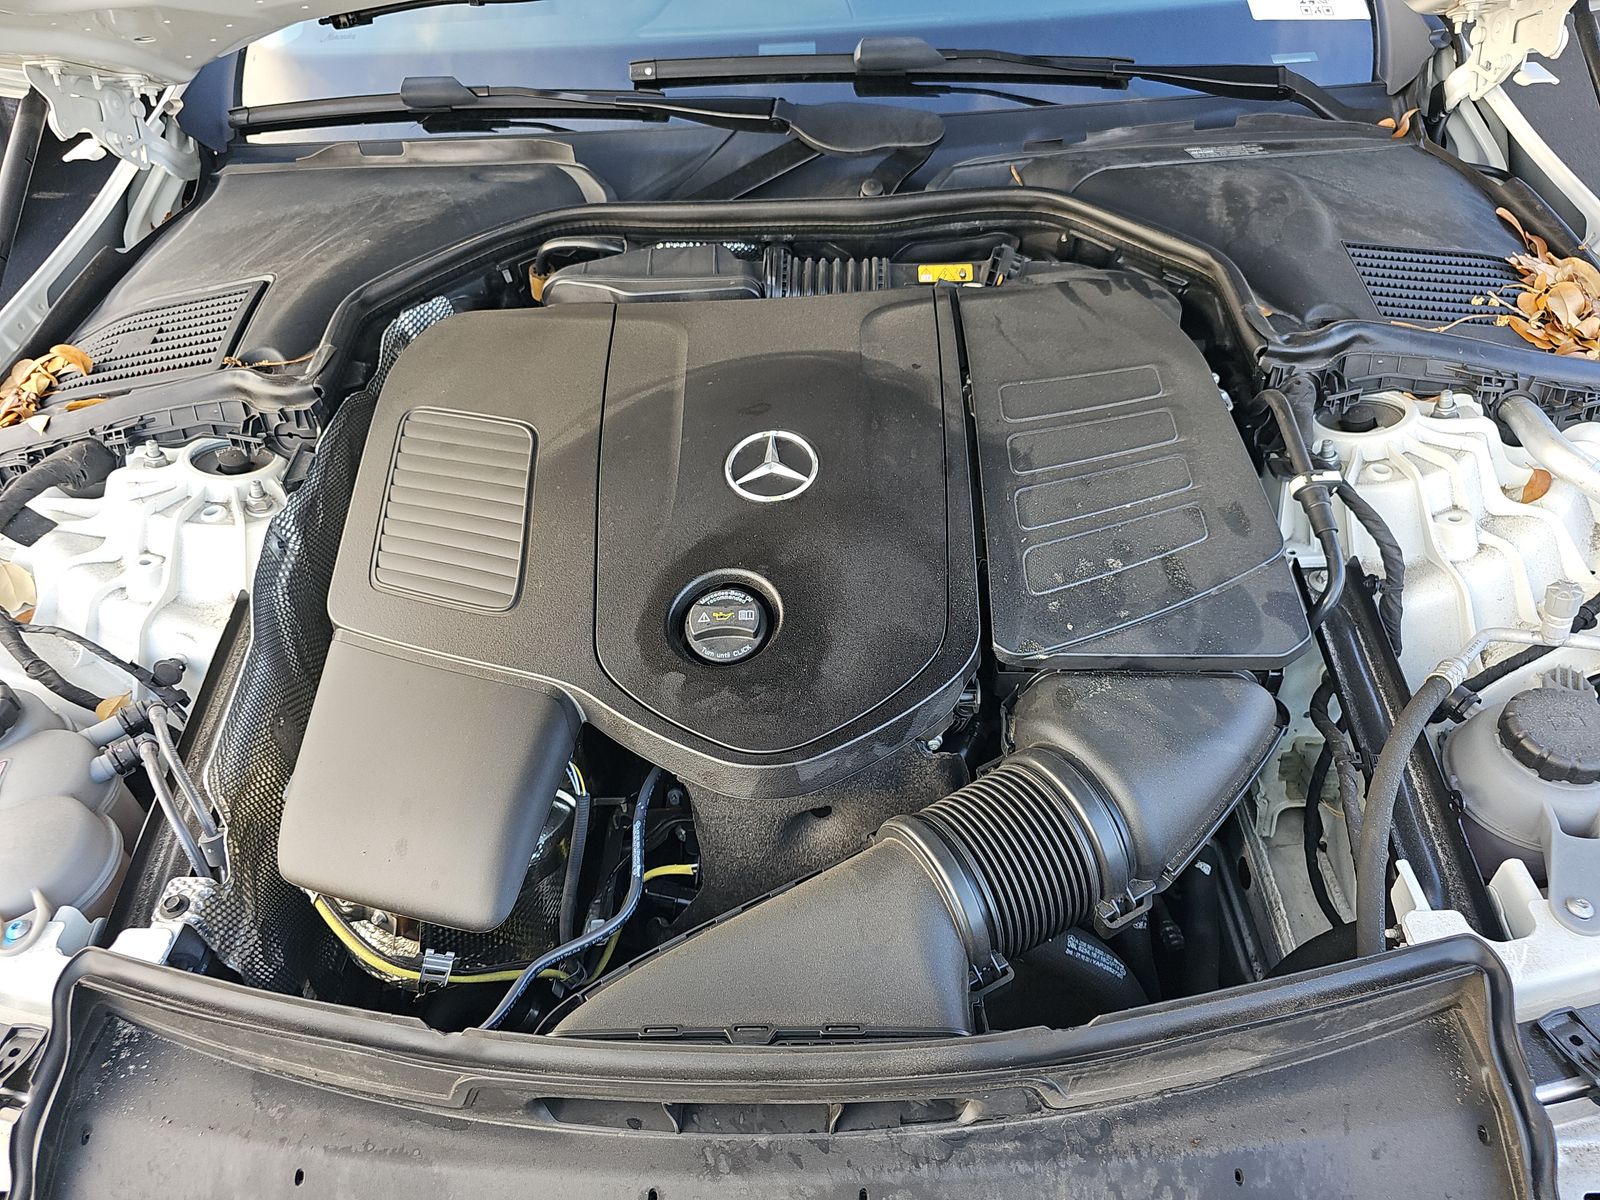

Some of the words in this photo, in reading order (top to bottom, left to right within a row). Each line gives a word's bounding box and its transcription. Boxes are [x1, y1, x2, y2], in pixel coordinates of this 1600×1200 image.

[700, 590, 745, 605] Mercedes-Benz
[706, 595, 747, 605] recommended
[701, 646, 715, 657] Turn
[716, 651, 731, 659] until
[732, 644, 752, 657] CLICK
